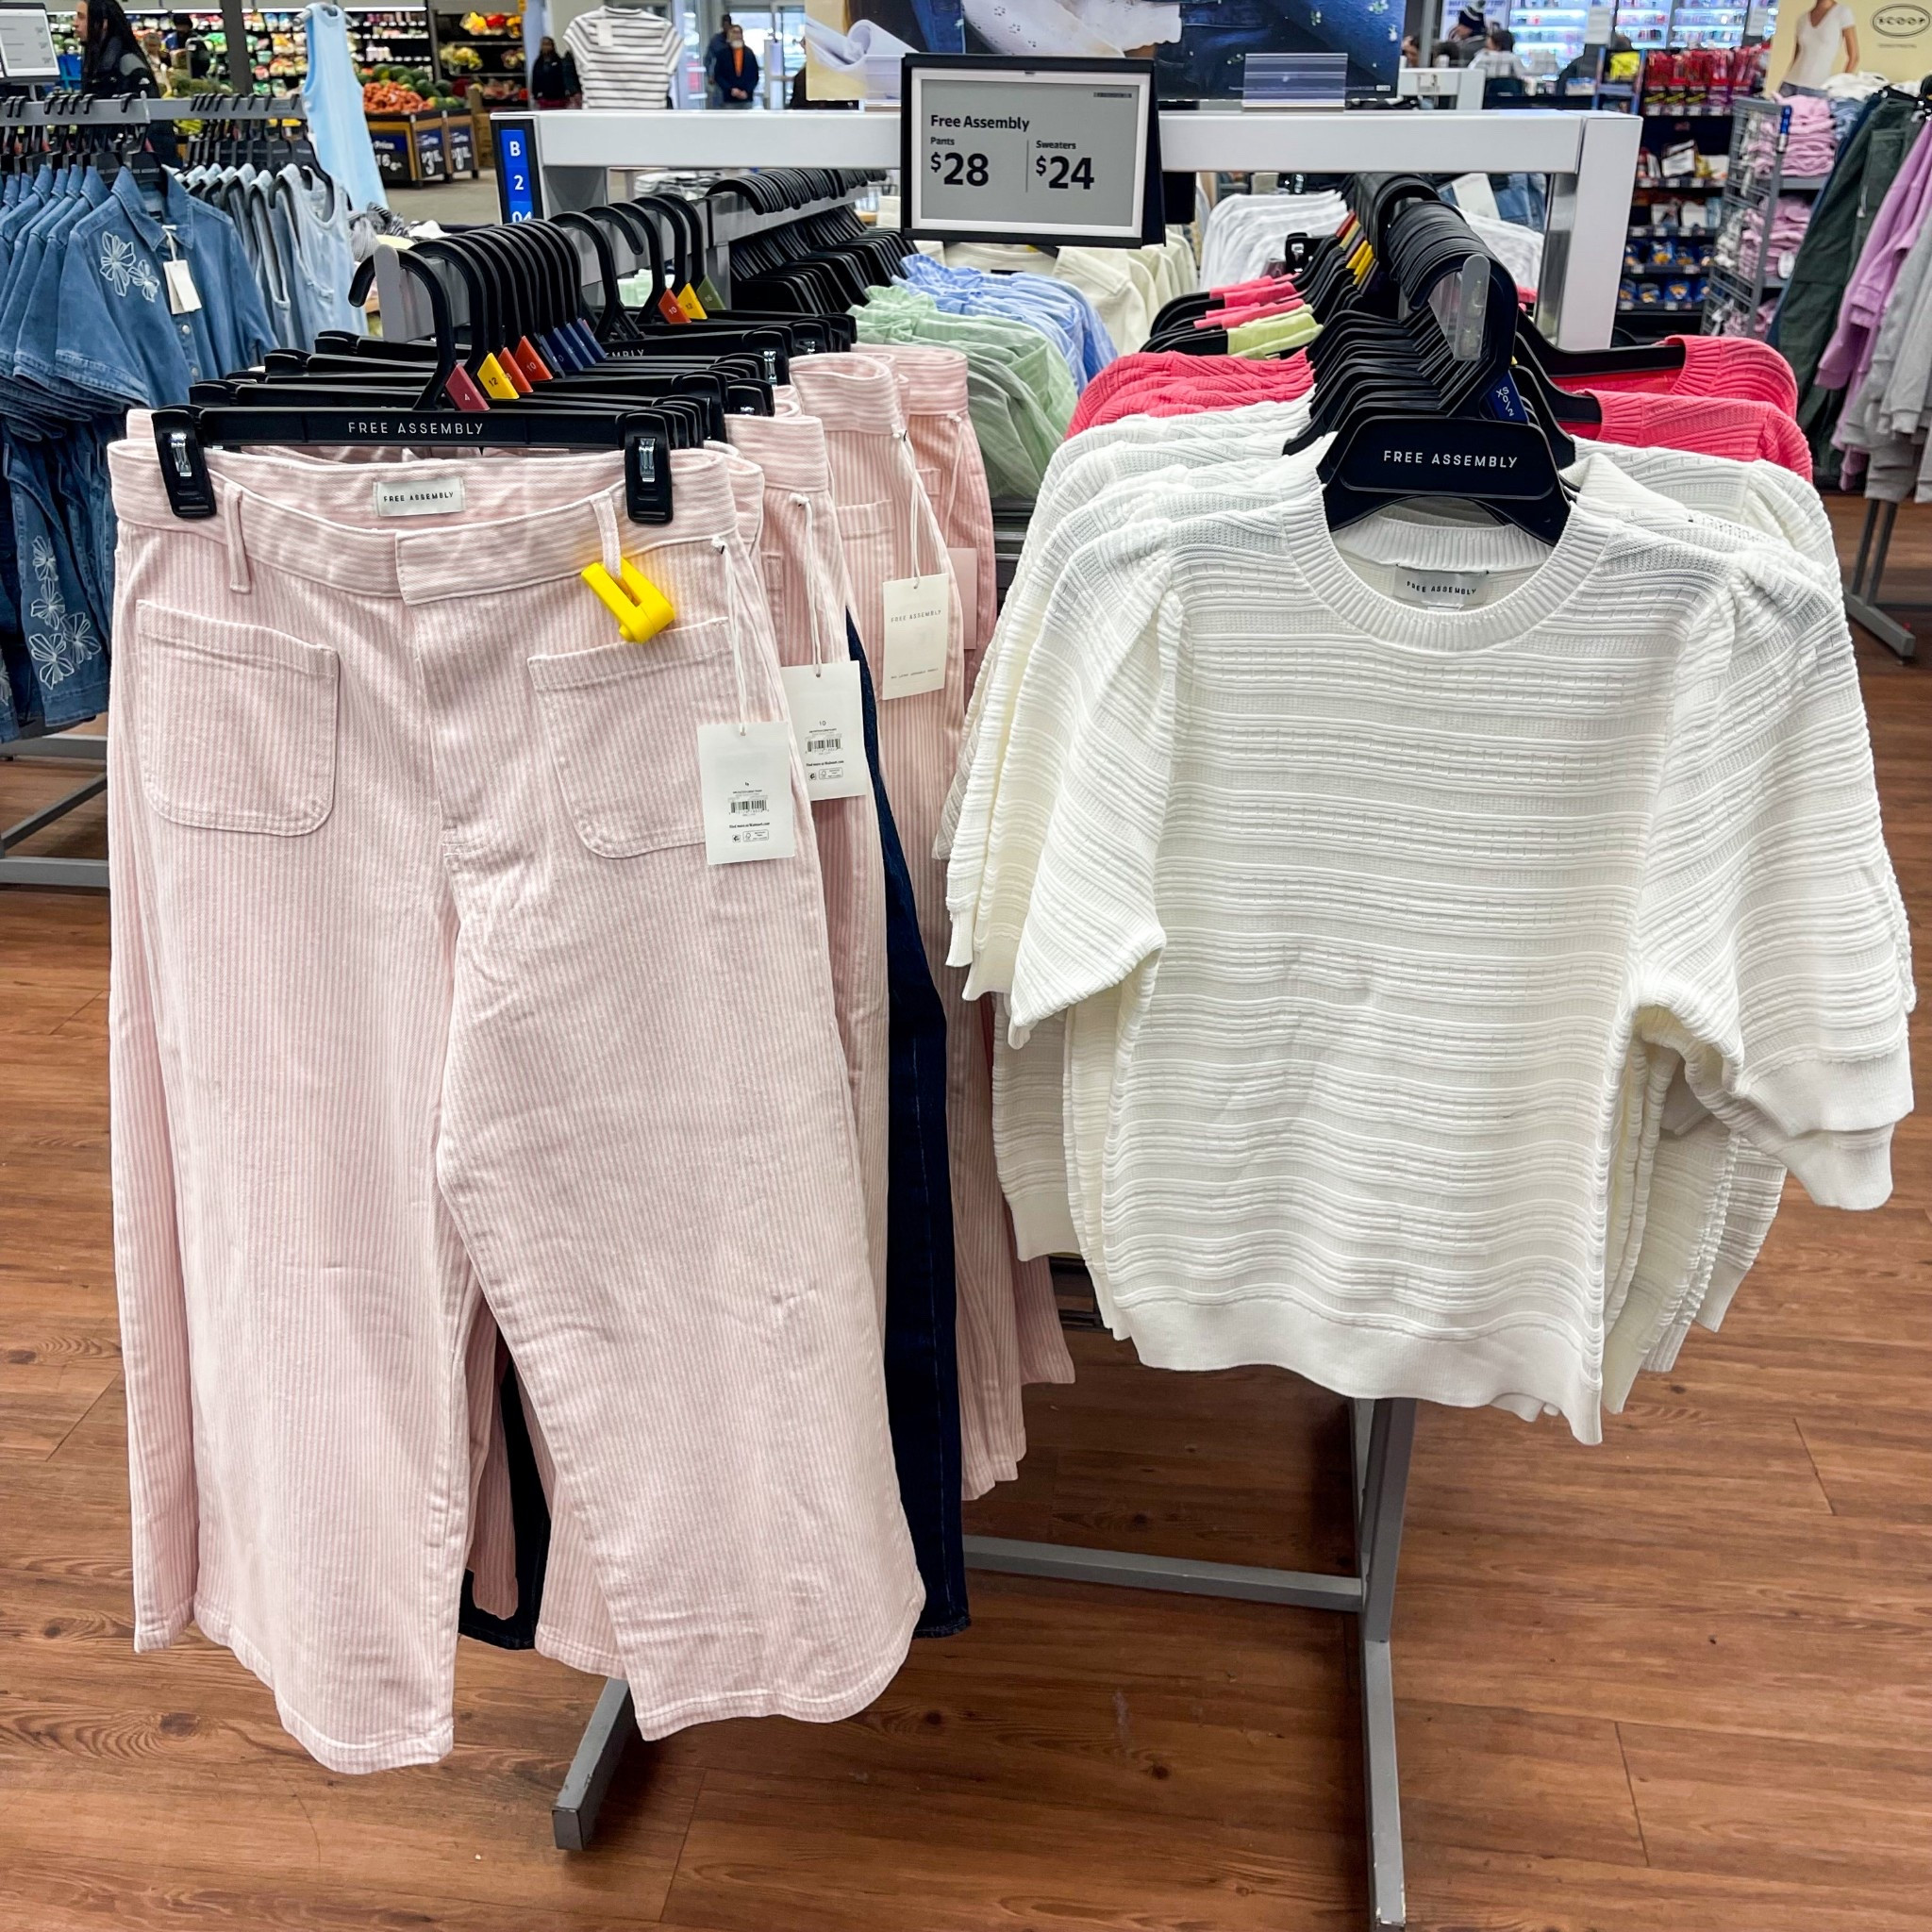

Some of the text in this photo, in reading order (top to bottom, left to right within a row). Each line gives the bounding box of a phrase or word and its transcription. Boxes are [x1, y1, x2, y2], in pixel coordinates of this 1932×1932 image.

[930, 114, 1030, 132] Free Assembly
[930, 137, 955, 145] Pants
[1036, 140, 1076, 150] Sweaters
[509, 141, 521, 157] B
[930, 151, 989, 187] $28
[1036, 155, 1094, 190] $24
[513, 175, 525, 191] 2
[489, 377, 498, 386] 12
[1495, 386, 1509, 398] XS
[348, 422, 483, 435] FREE ASSEMBLY
[1383, 450, 1518, 469] FREE ASSEMBLY
[409, 491, 454, 501] ASSEMBLY
[1407, 580, 1476, 595] FREE ASSEMBLY
[909, 609, 941, 620] ASSEMBLY
